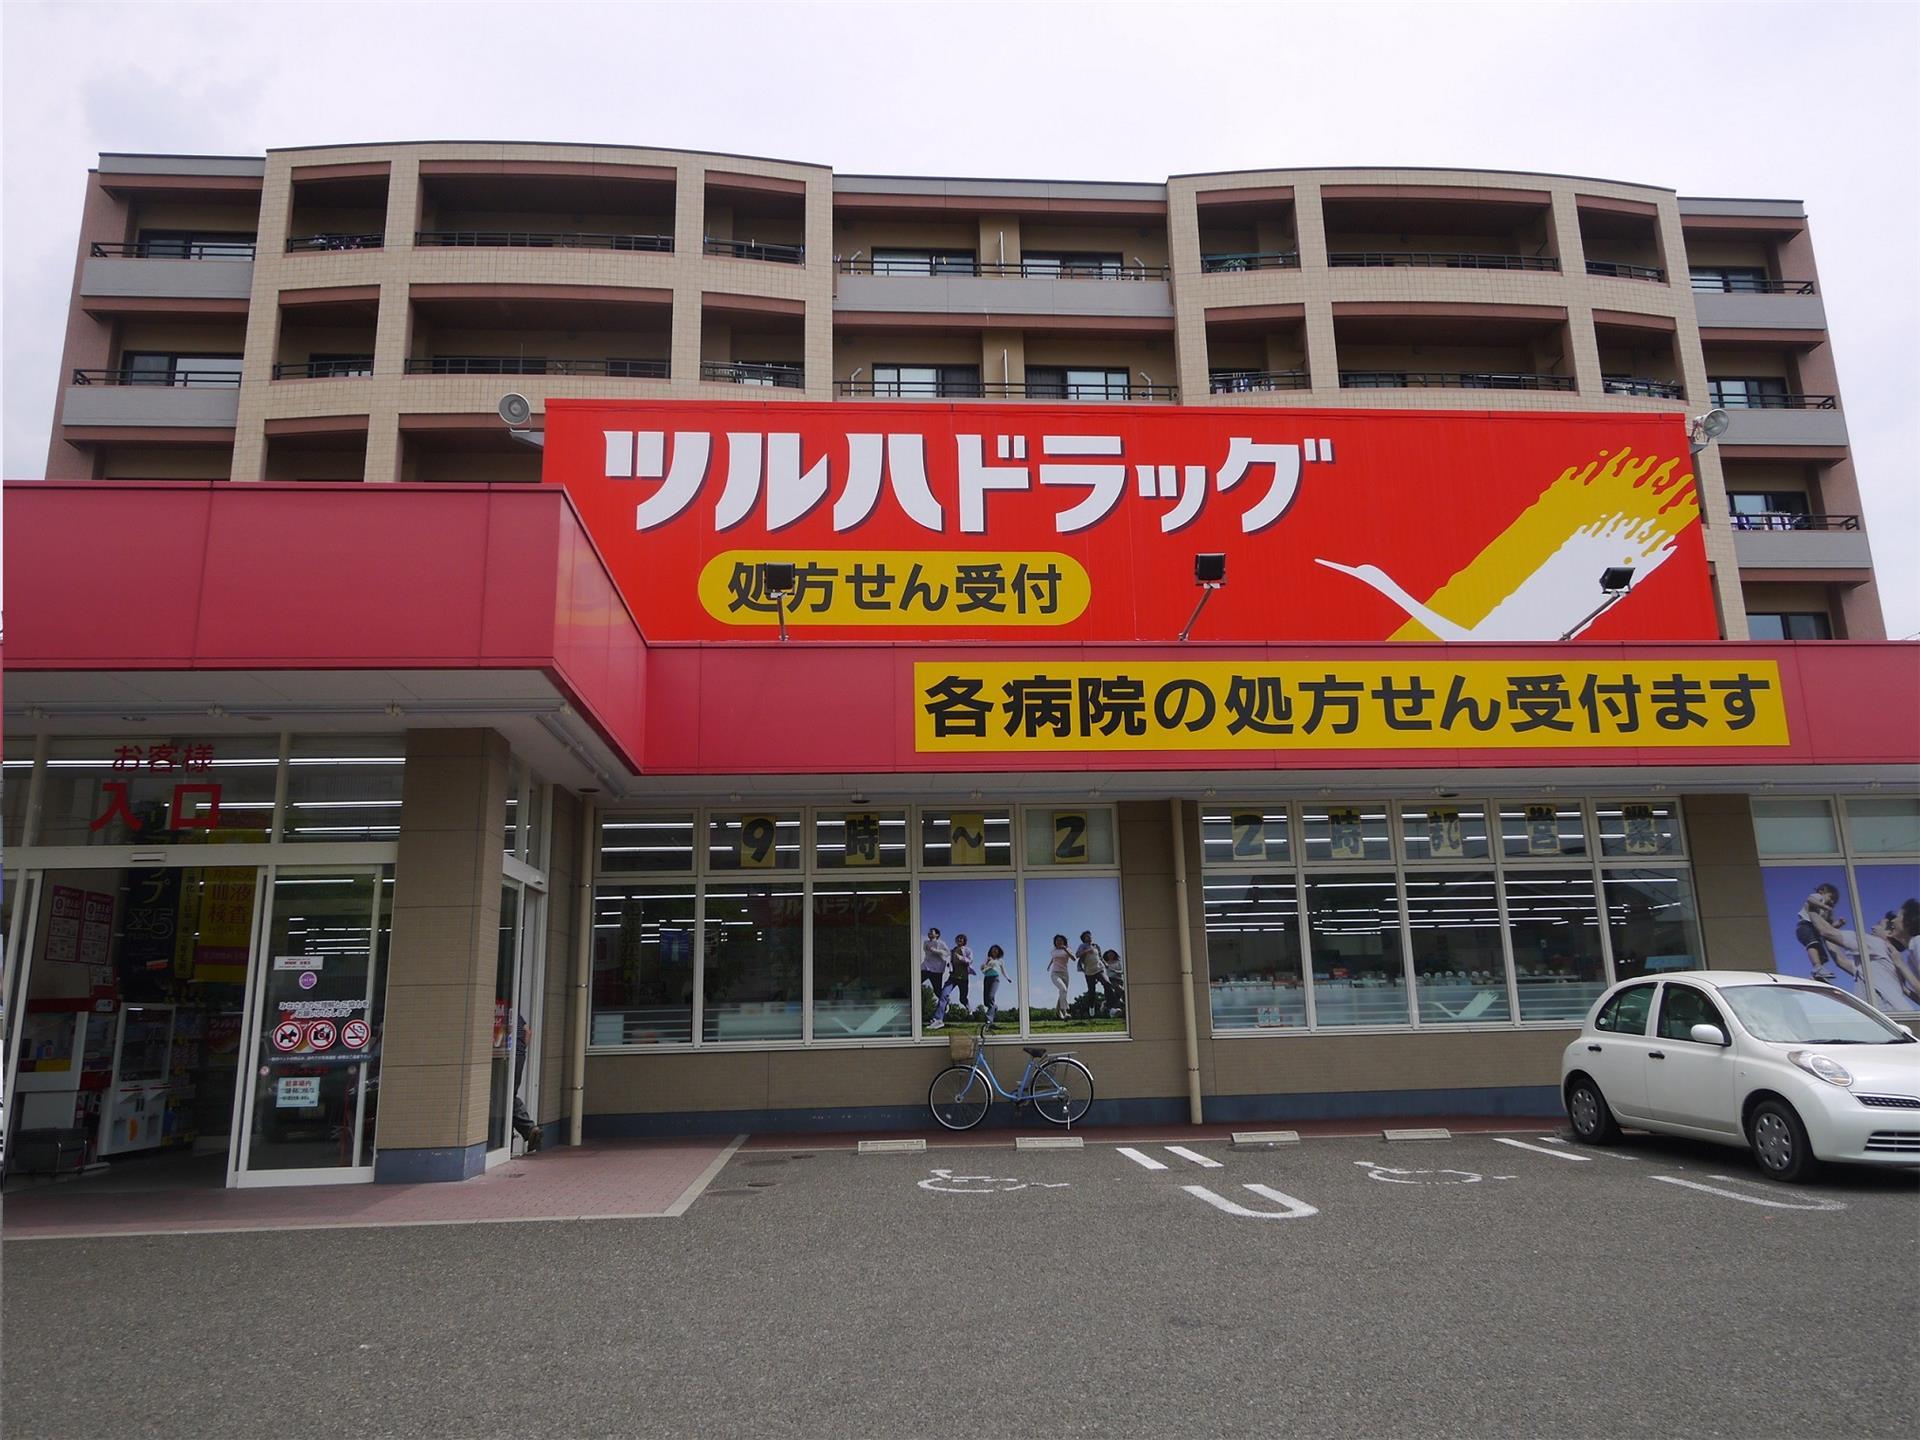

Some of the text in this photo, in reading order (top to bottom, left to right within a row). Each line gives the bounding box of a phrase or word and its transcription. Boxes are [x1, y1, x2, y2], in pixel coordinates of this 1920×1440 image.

[603, 431, 1334, 535] ツルハドラッグ
[727, 561, 1063, 614] 処方せん受付
[925, 673, 1771, 738] 各病院の処方せん受付ます
[112, 744, 215, 773] お客様
[88, 782, 222, 832] 入口
